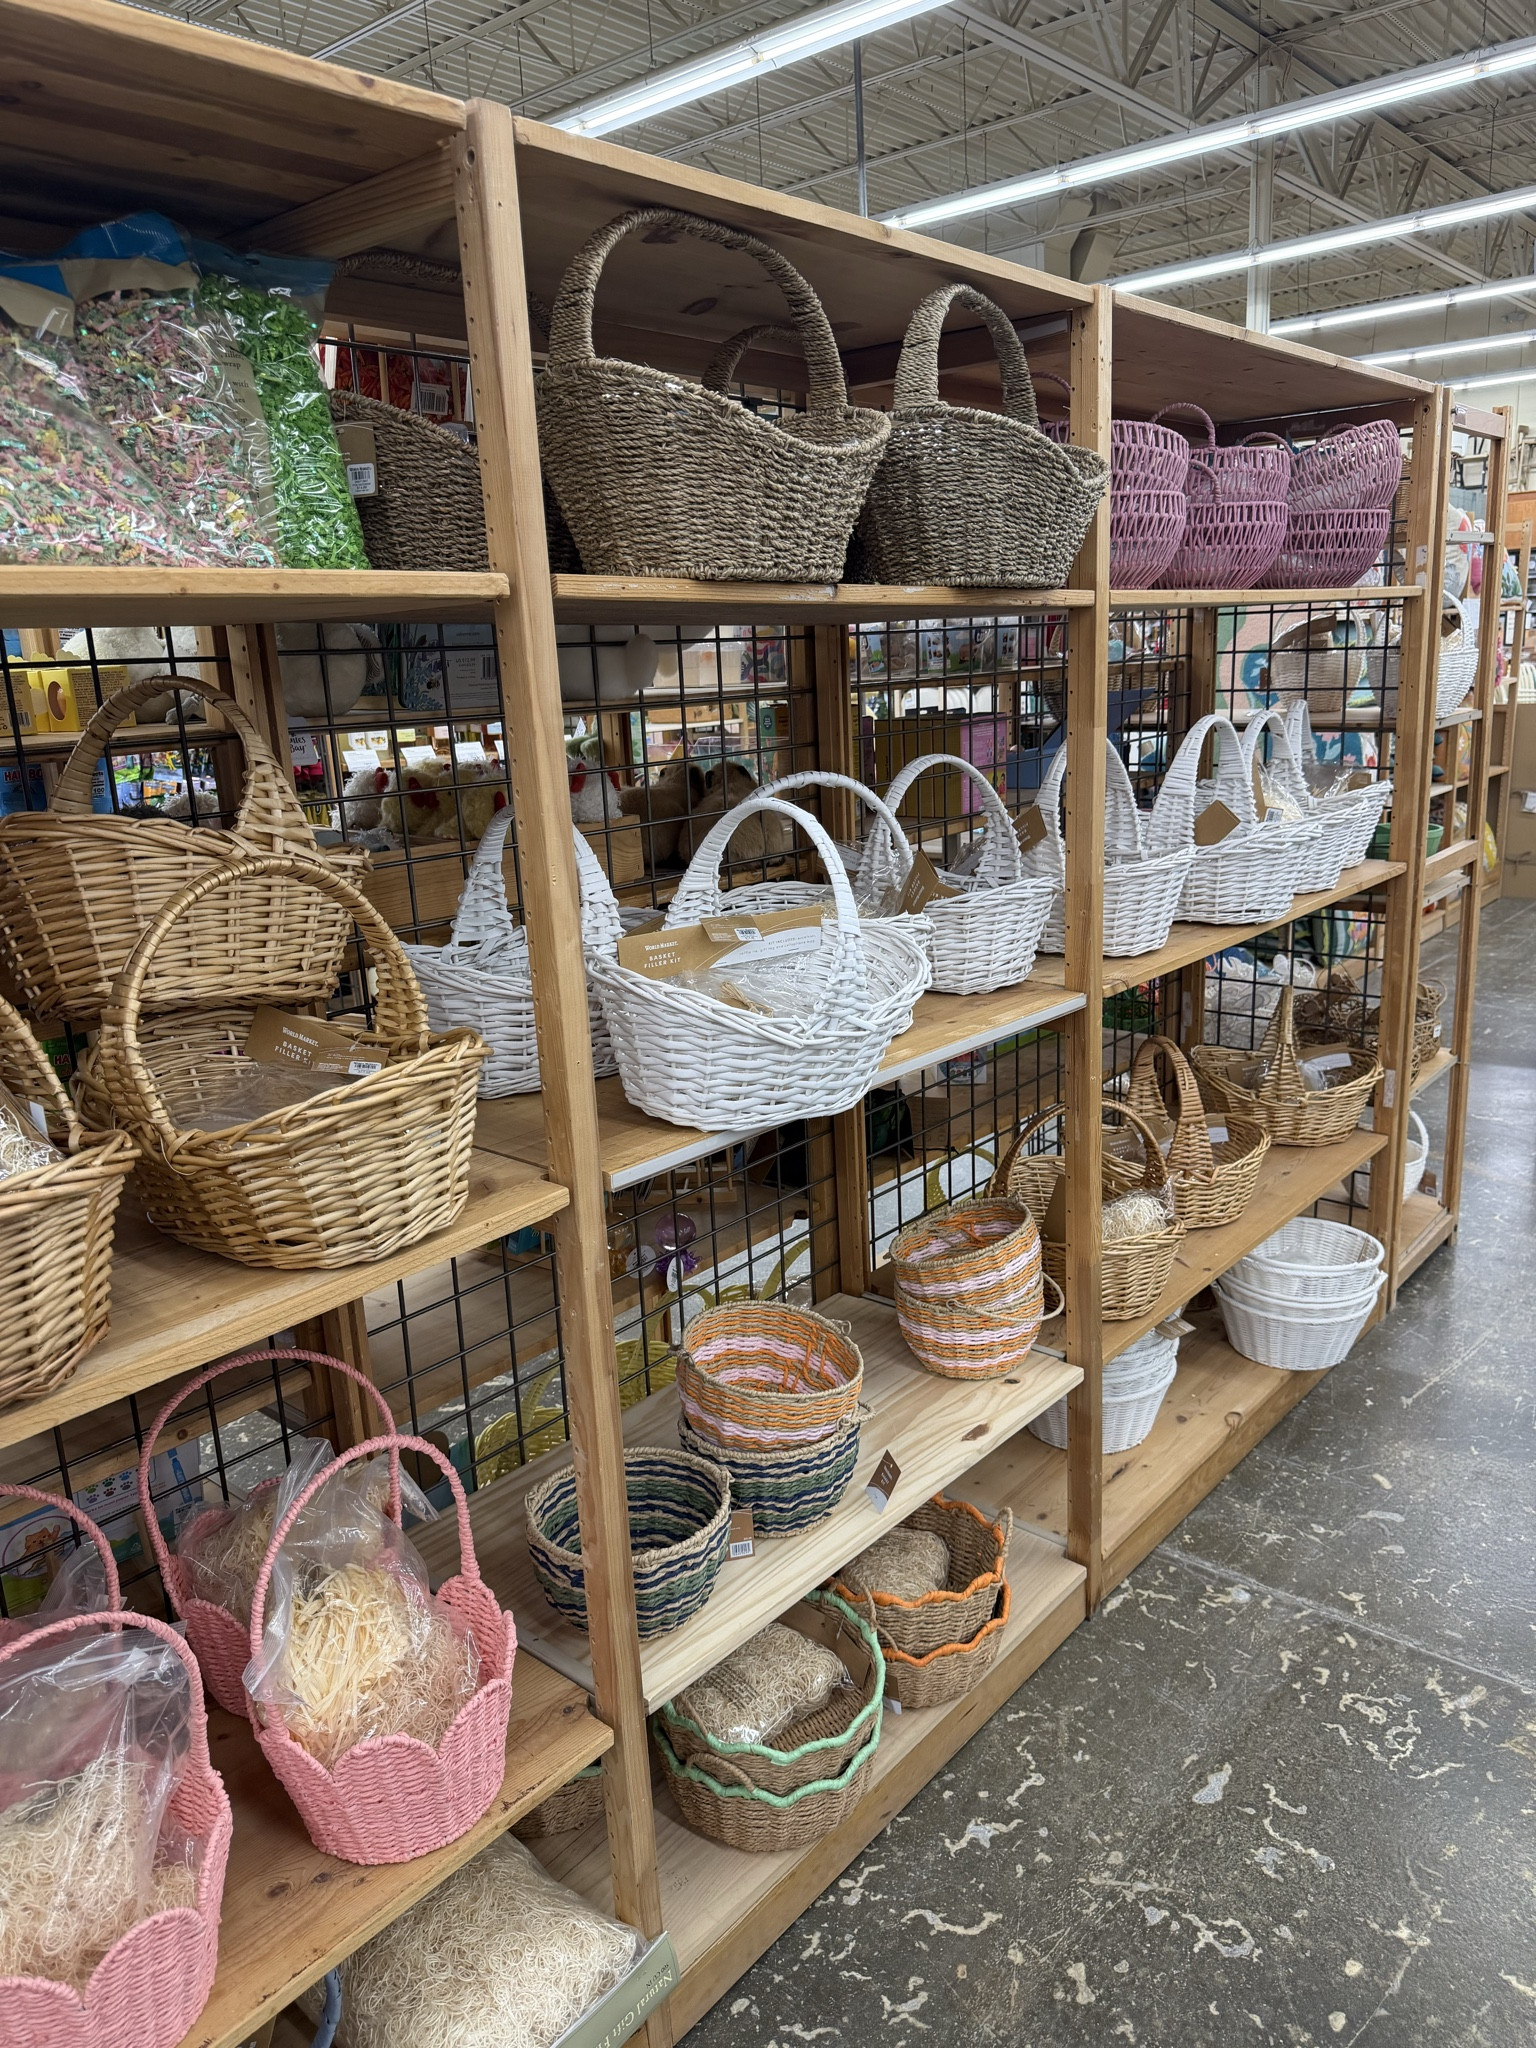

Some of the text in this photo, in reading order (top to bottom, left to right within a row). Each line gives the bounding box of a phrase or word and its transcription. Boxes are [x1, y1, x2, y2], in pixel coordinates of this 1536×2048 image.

[644, 959, 667, 969] FILLER
[649, 952, 676, 961] BASKET
[282, 1026, 299, 1040] WORLD
[274, 1045, 301, 1061] FILLER
[282, 1040, 312, 1057] BASKET
[645, 1979, 653, 1989] IN
[636, 1970, 673, 2016] Natural
[612, 2011, 635, 2037] Gift
